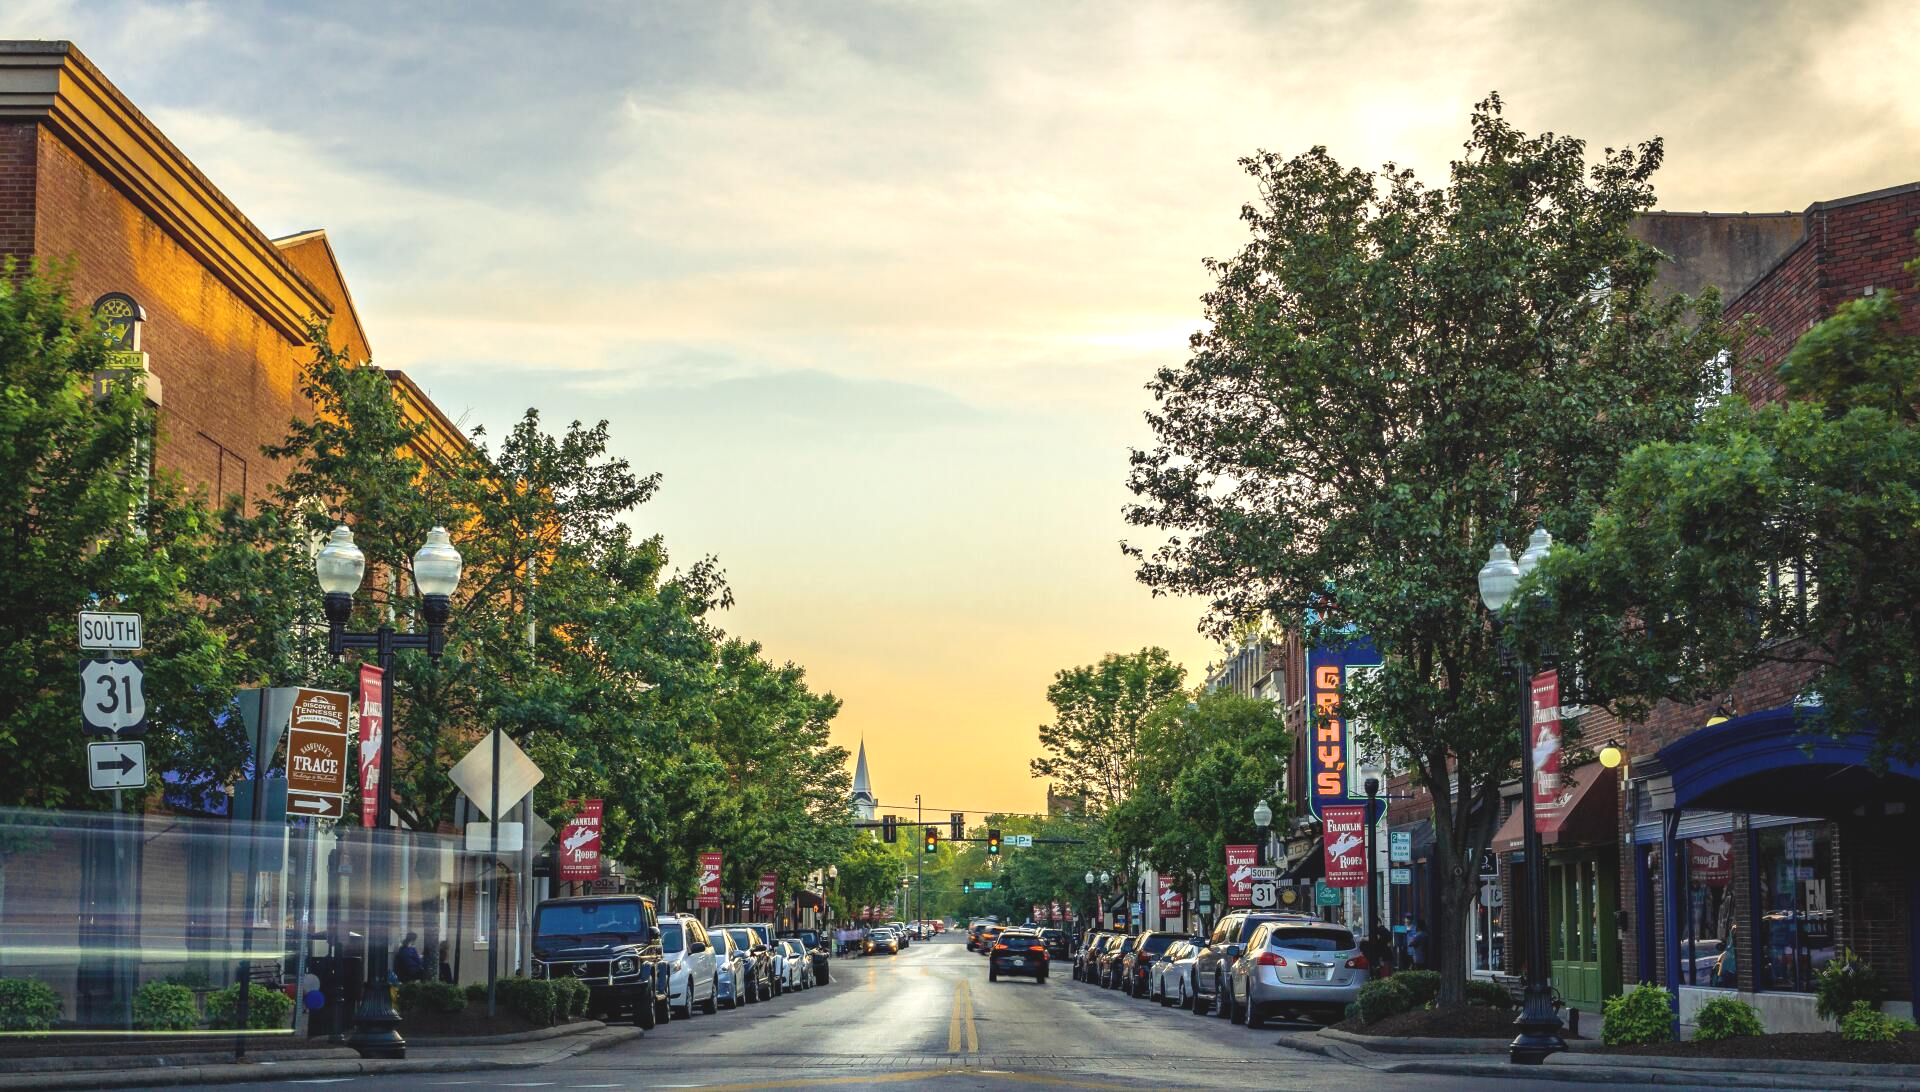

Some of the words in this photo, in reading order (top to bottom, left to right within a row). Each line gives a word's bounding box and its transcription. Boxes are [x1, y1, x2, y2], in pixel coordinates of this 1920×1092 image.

[84, 620, 136, 641] SOUTH
[96, 674, 132, 714] 31
[295, 706, 343, 720] TENNESSEE
[302, 702, 336, 711] DISCOVER
[293, 755, 338, 774] TRACE
[1327, 819, 1361, 832] FRANKLIN
[574, 848, 598, 862] RODEO
[1229, 855, 1255, 865] FRANKLIN
[1340, 855, 1362, 868] RODEO
[1252, 869, 1275, 878] SOUTH
[1256, 887, 1271, 902] 31
